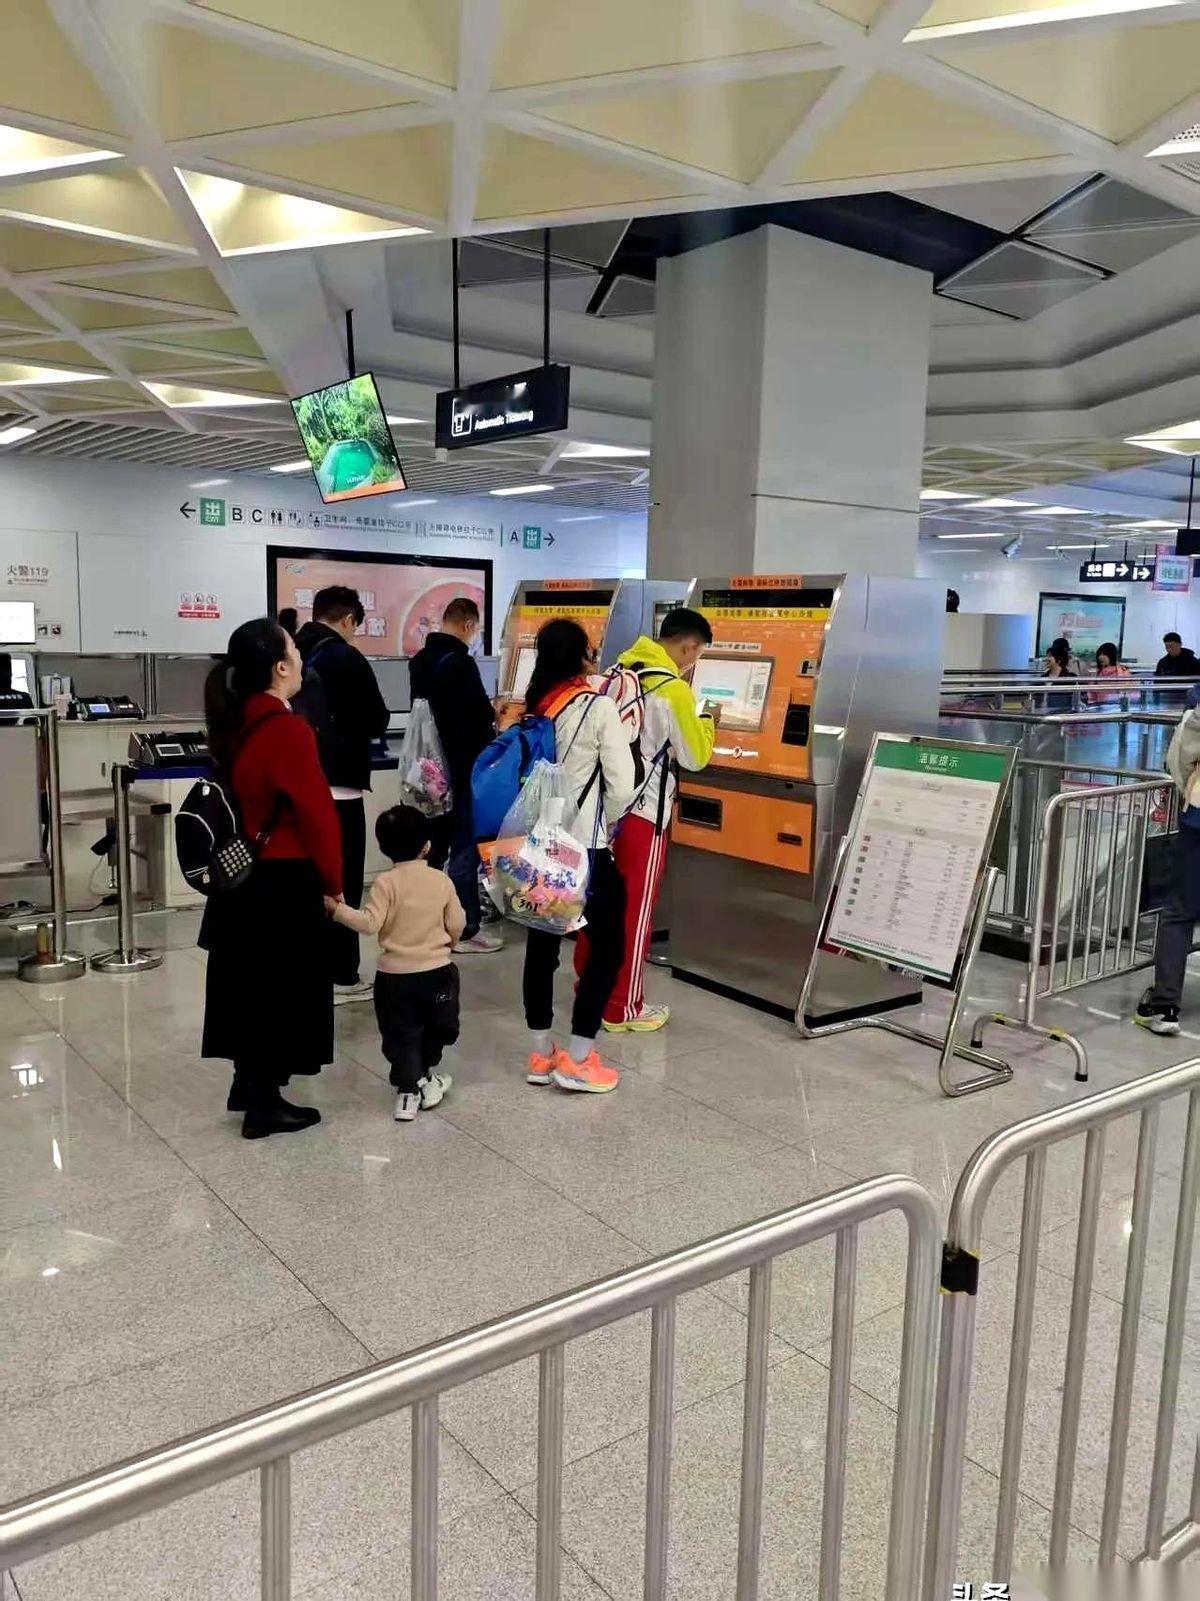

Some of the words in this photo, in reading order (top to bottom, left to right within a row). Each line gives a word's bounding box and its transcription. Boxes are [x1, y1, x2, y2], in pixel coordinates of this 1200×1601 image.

[232, 508, 243, 521] B
[252, 509, 263, 523] C
[510, 530, 519, 542] A
